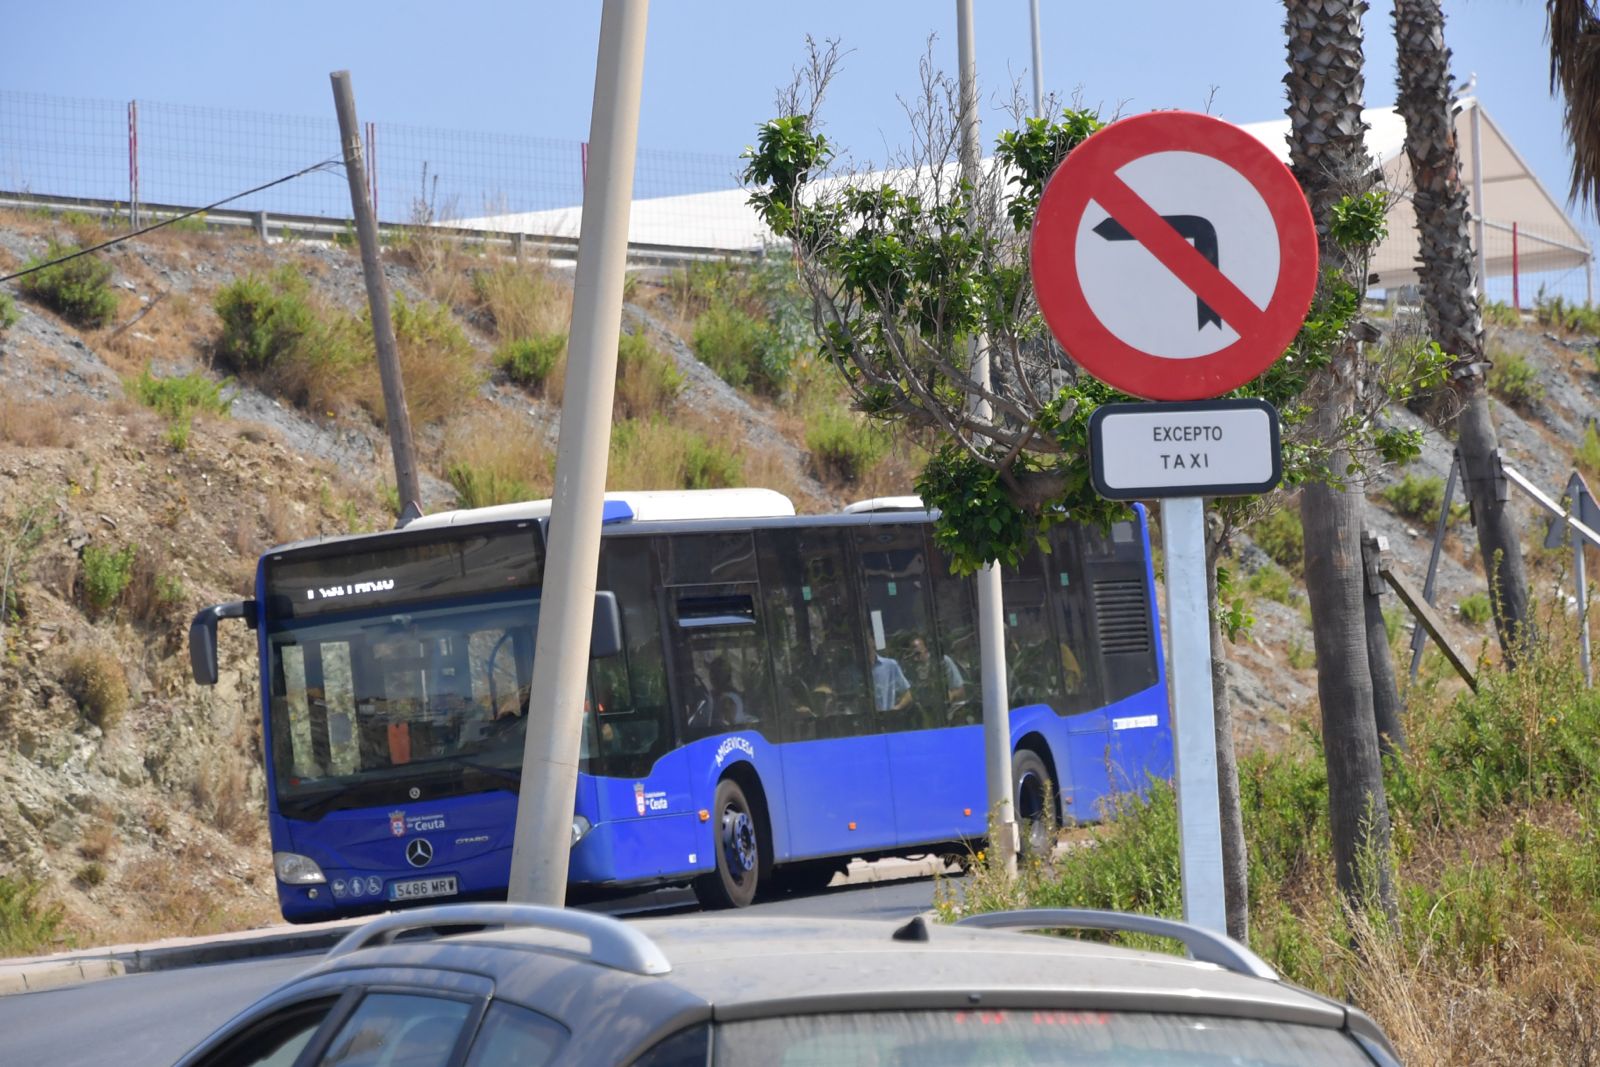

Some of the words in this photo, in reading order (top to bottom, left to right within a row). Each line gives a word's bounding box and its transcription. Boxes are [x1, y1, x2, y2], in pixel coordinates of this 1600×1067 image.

[1153, 426, 1223, 441] EXCEPTO
[1160, 453, 1209, 469] TAXI
[415, 819, 445, 831] Ceuta
[396, 882, 428, 897] 5486
